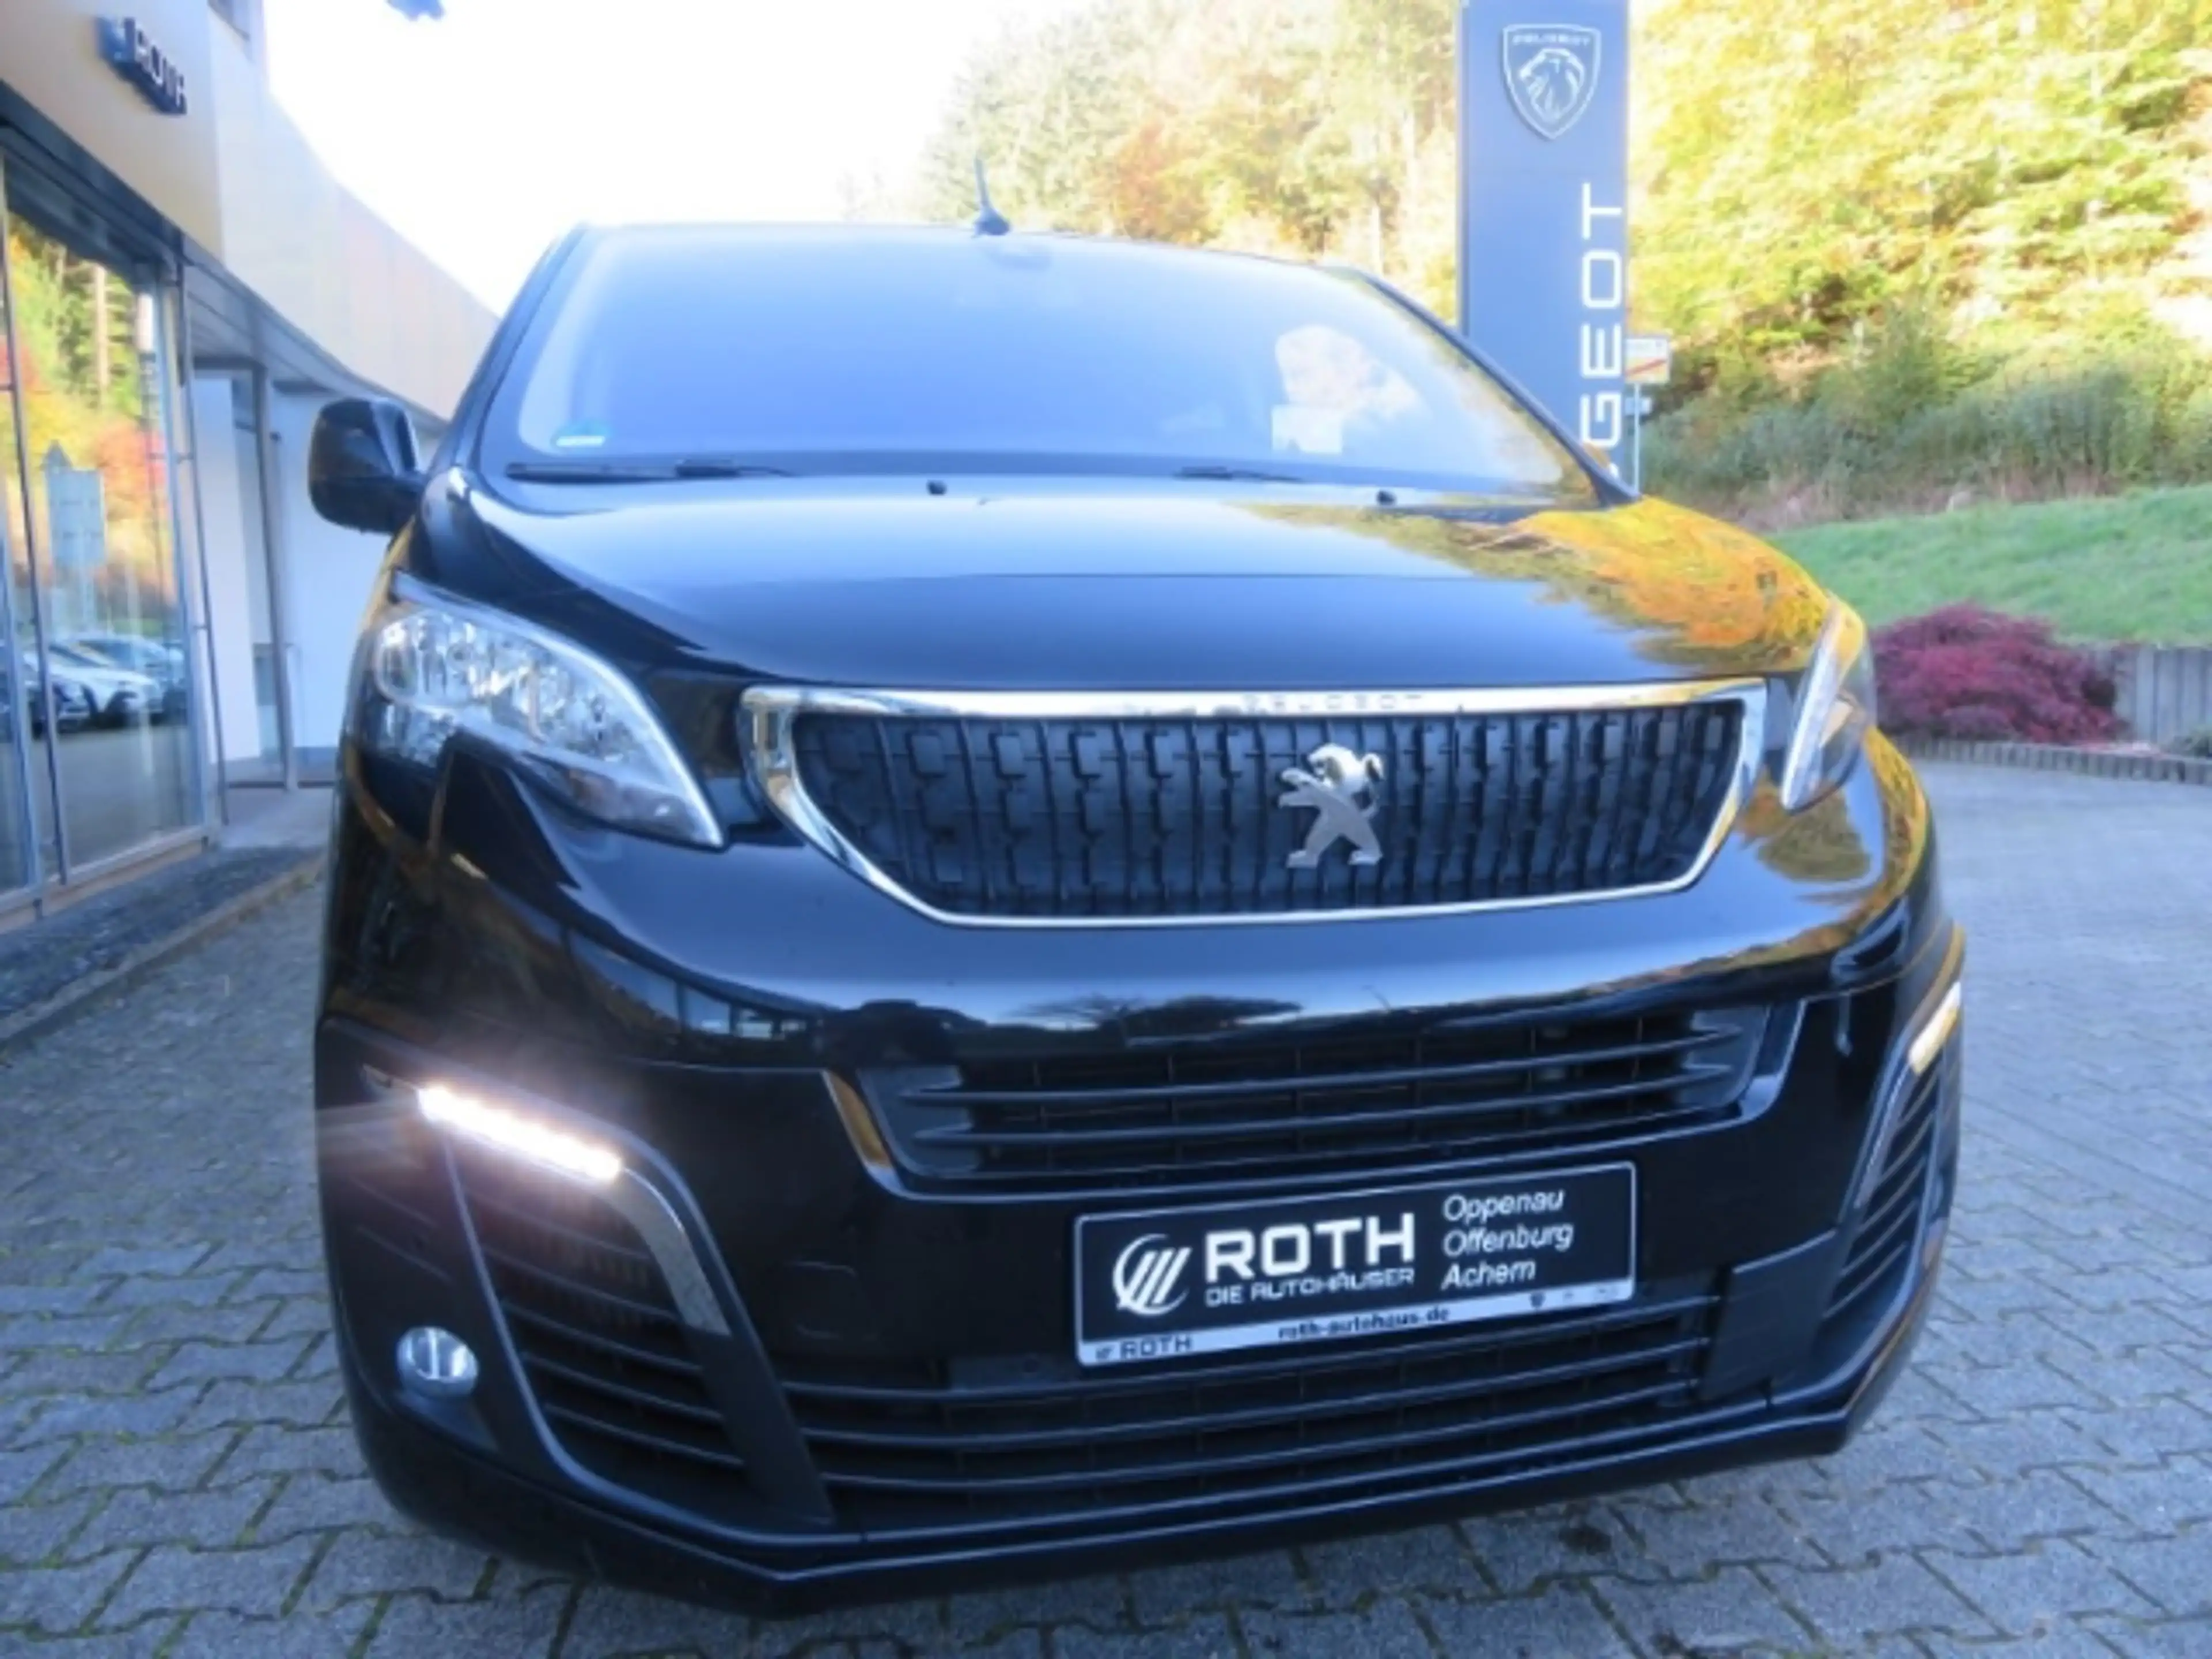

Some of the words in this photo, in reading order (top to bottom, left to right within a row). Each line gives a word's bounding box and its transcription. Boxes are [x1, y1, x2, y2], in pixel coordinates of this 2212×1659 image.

[1580, 181, 1623, 479] GEOT
[1442, 1188, 1566, 1225] Oppenau
[1206, 1212, 1415, 1283] ROTH
[1443, 1222, 1574, 1257] Offenburg
[1205, 1284, 1243, 1308] DIE
[1120, 1333, 1192, 1359] ROTH
